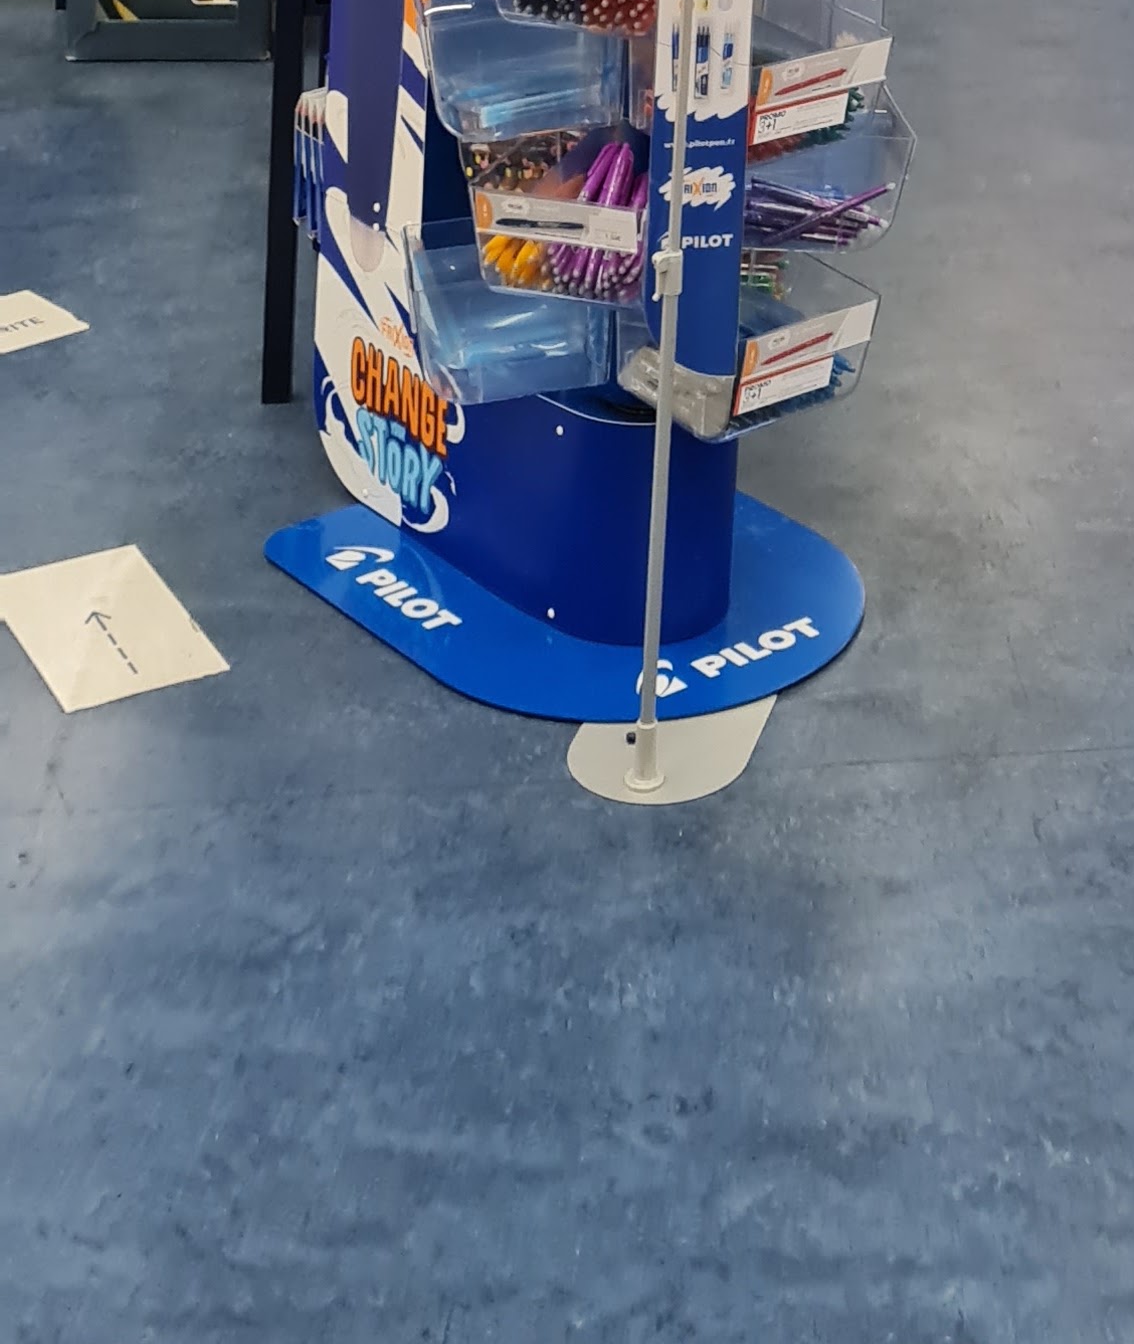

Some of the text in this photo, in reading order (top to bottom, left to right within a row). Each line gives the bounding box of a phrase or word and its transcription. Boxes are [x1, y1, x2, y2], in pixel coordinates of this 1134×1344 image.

[681, 234, 734, 249] PILOT
[351, 336, 448, 458] CHANGE
[355, 568, 463, 630] PILOT
[690, 616, 820, 678] PILOT
